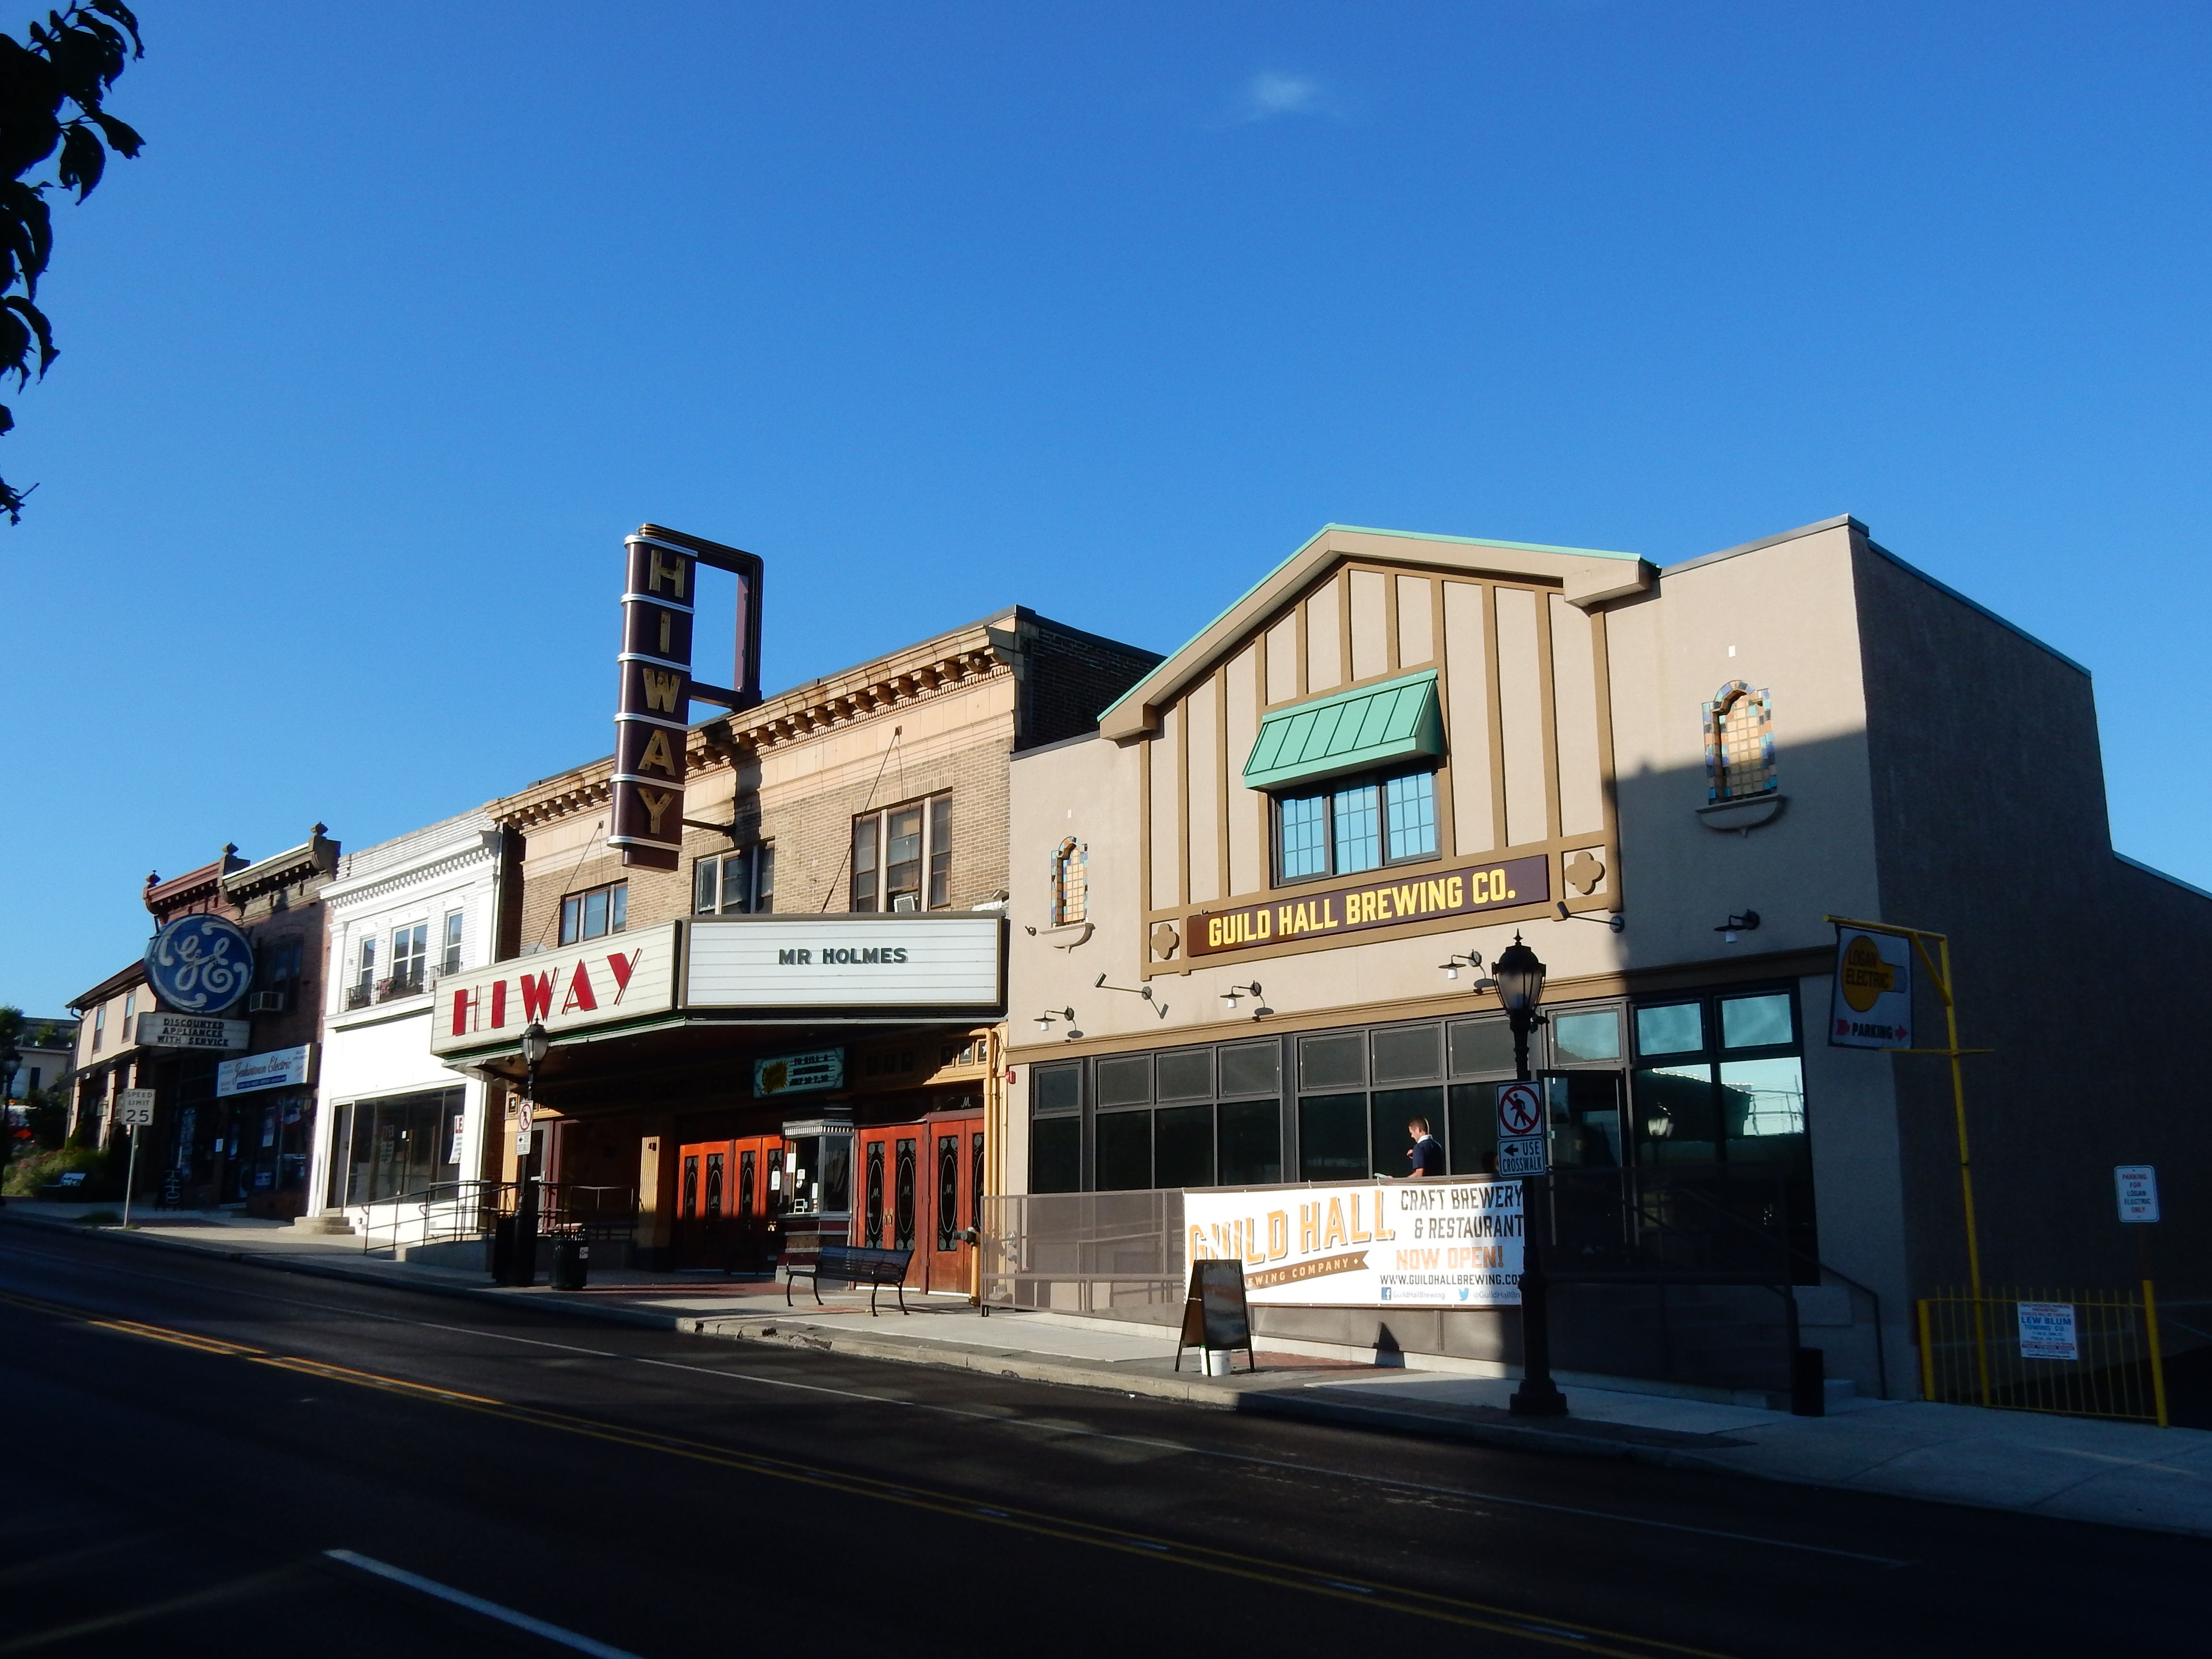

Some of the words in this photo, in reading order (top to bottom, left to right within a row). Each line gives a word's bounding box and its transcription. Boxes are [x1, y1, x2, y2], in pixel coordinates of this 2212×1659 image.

[637, 550, 685, 834] HIWAY
[1209, 908, 1271, 947] GUILD
[1278, 898, 1338, 936] HALL
[1346, 876, 1463, 926] BREWING
[1472, 868, 1516, 904] CO.
[778, 949, 812, 965] MR
[822, 947, 909, 964] HOLMES
[1846, 967, 1889, 989] ELECTRIC
[452, 948, 643, 1036] HIWAY
[162, 1027, 223, 1038] APPLIANCES
[163, 1018, 225, 1030] DISCOUNTED
[1851, 1022, 1893, 1040] PARKING
[157, 1035, 182, 1044] WITH
[188, 1036, 229, 1047] SERVICE
[126, 1109, 149, 1122] 25
[1522, 1141, 1540, 1156] USE
[1503, 1156, 1542, 1173] CROSSWALK
[1401, 1189, 1445, 1211] CRAFT
[1451, 1184, 1523, 1210] BREWERY
[1299, 1190, 1396, 1254] HALL
[1414, 1217, 1424, 1239] &
[1428, 1214, 1524, 1239] RESTAURANT
[1396, 1248, 1441, 1271] NOW
[1447, 1245, 1504, 1269] OPEN!
[1248, 1271, 1286, 1287] EWING
[1292, 1257, 1349, 1278] COMPANY
[1393, 1290, 1445, 1300] GuildHallBrewing
[2044, 1317, 2071, 1325] BLUM
